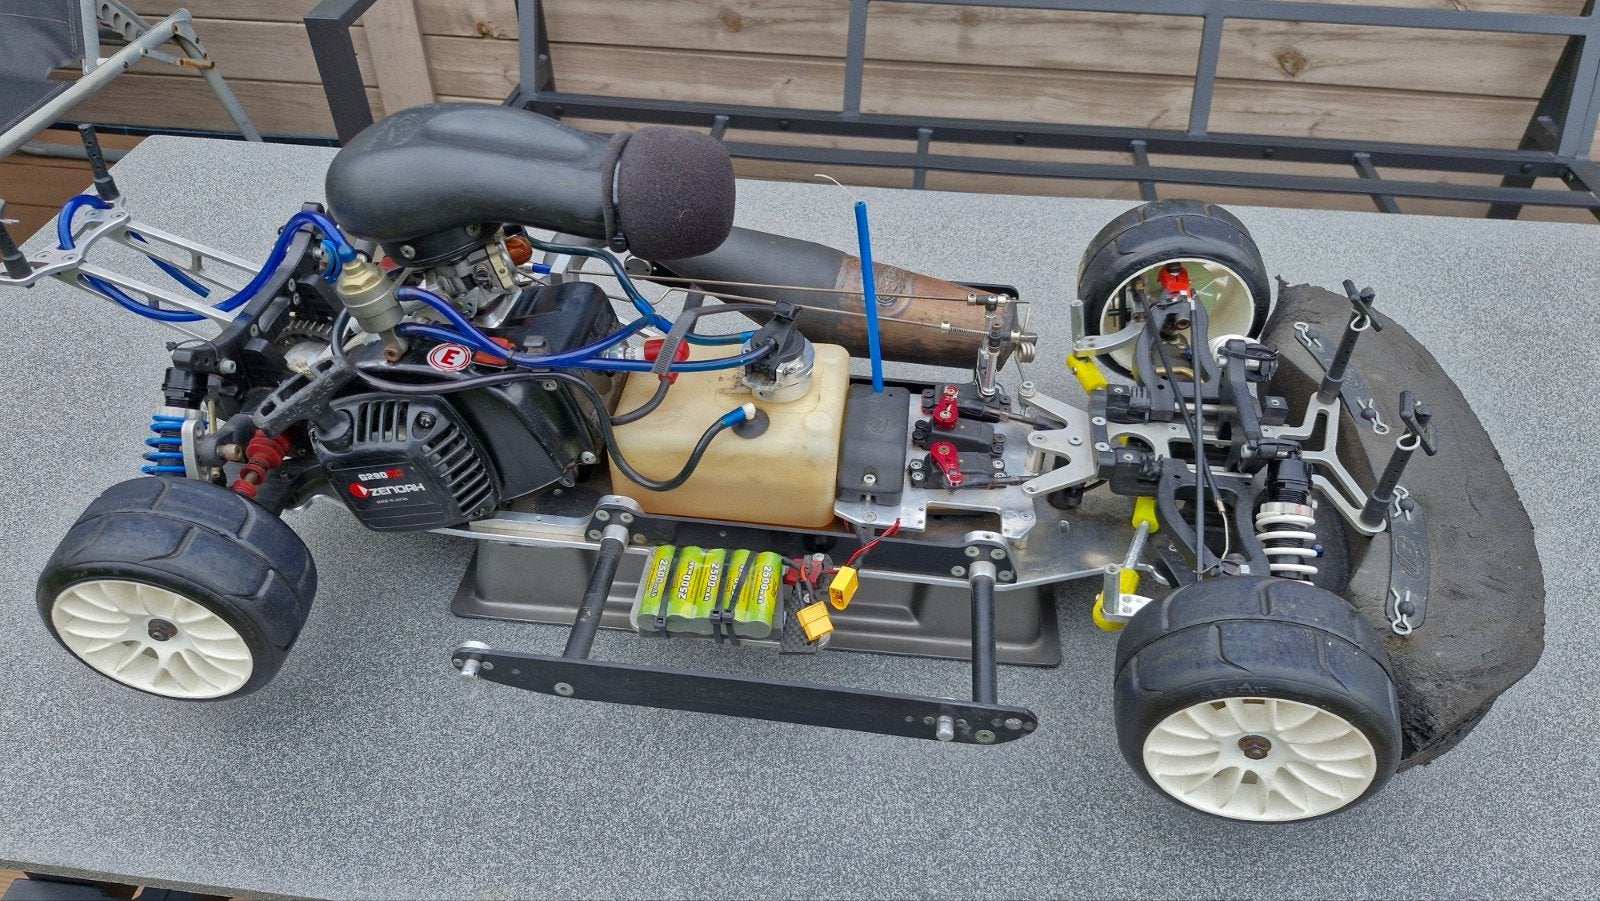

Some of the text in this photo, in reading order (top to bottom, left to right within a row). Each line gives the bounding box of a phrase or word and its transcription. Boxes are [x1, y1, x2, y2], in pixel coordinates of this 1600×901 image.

[441, 349, 461, 366] E
[369, 483, 426, 497] ZENOAH
[678, 561, 694, 600] 2500mAh
[704, 562, 720, 601] 2500mAh
[757, 565, 773, 605] 2500mAh
